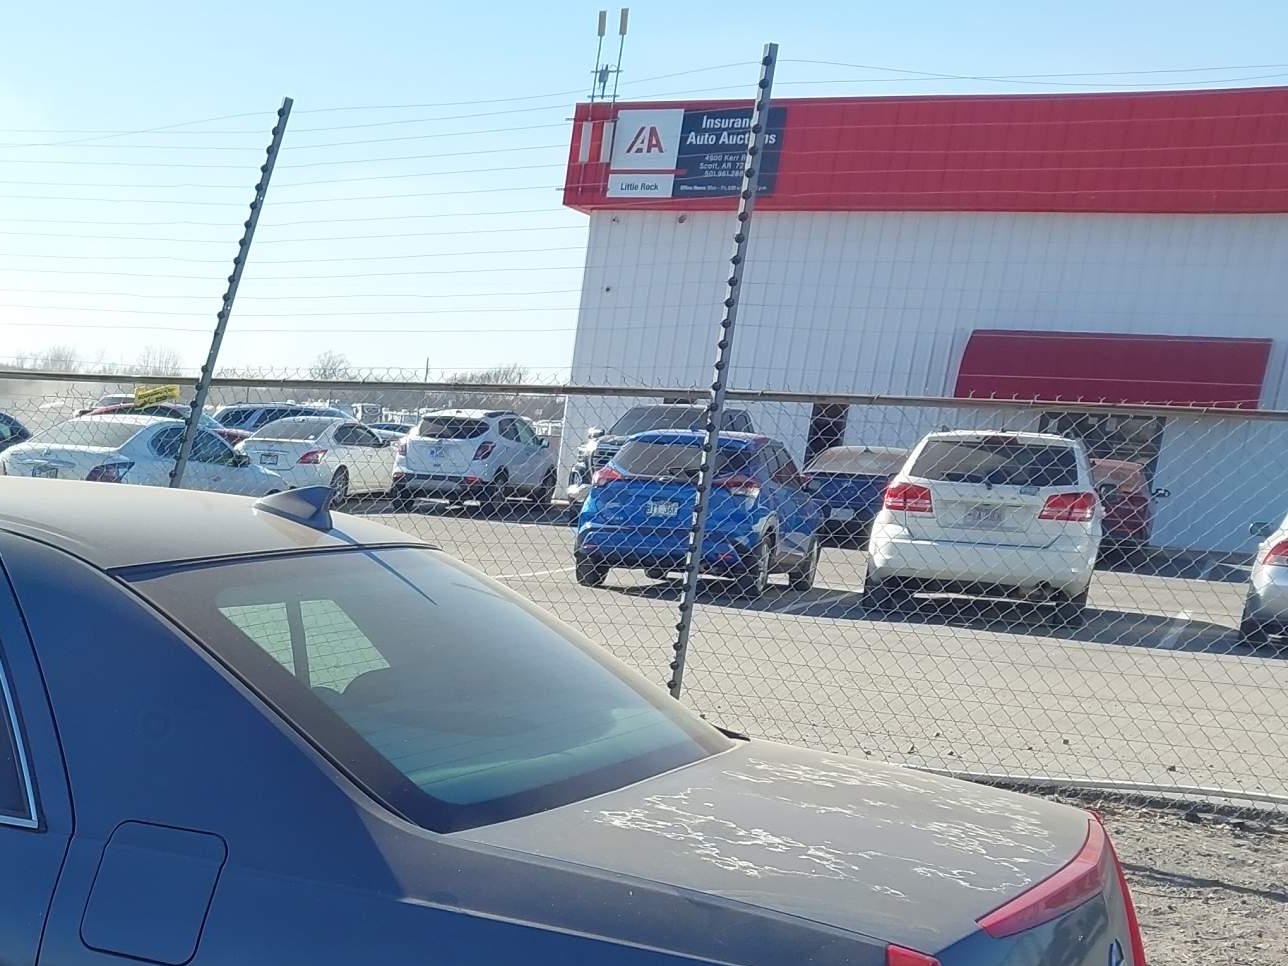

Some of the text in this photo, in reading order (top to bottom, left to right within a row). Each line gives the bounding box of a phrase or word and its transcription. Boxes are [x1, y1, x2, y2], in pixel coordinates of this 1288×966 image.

[702, 115, 755, 129] Insuran
[687, 131, 716, 145] Auto
[620, 181, 659, 192] Little Rock
